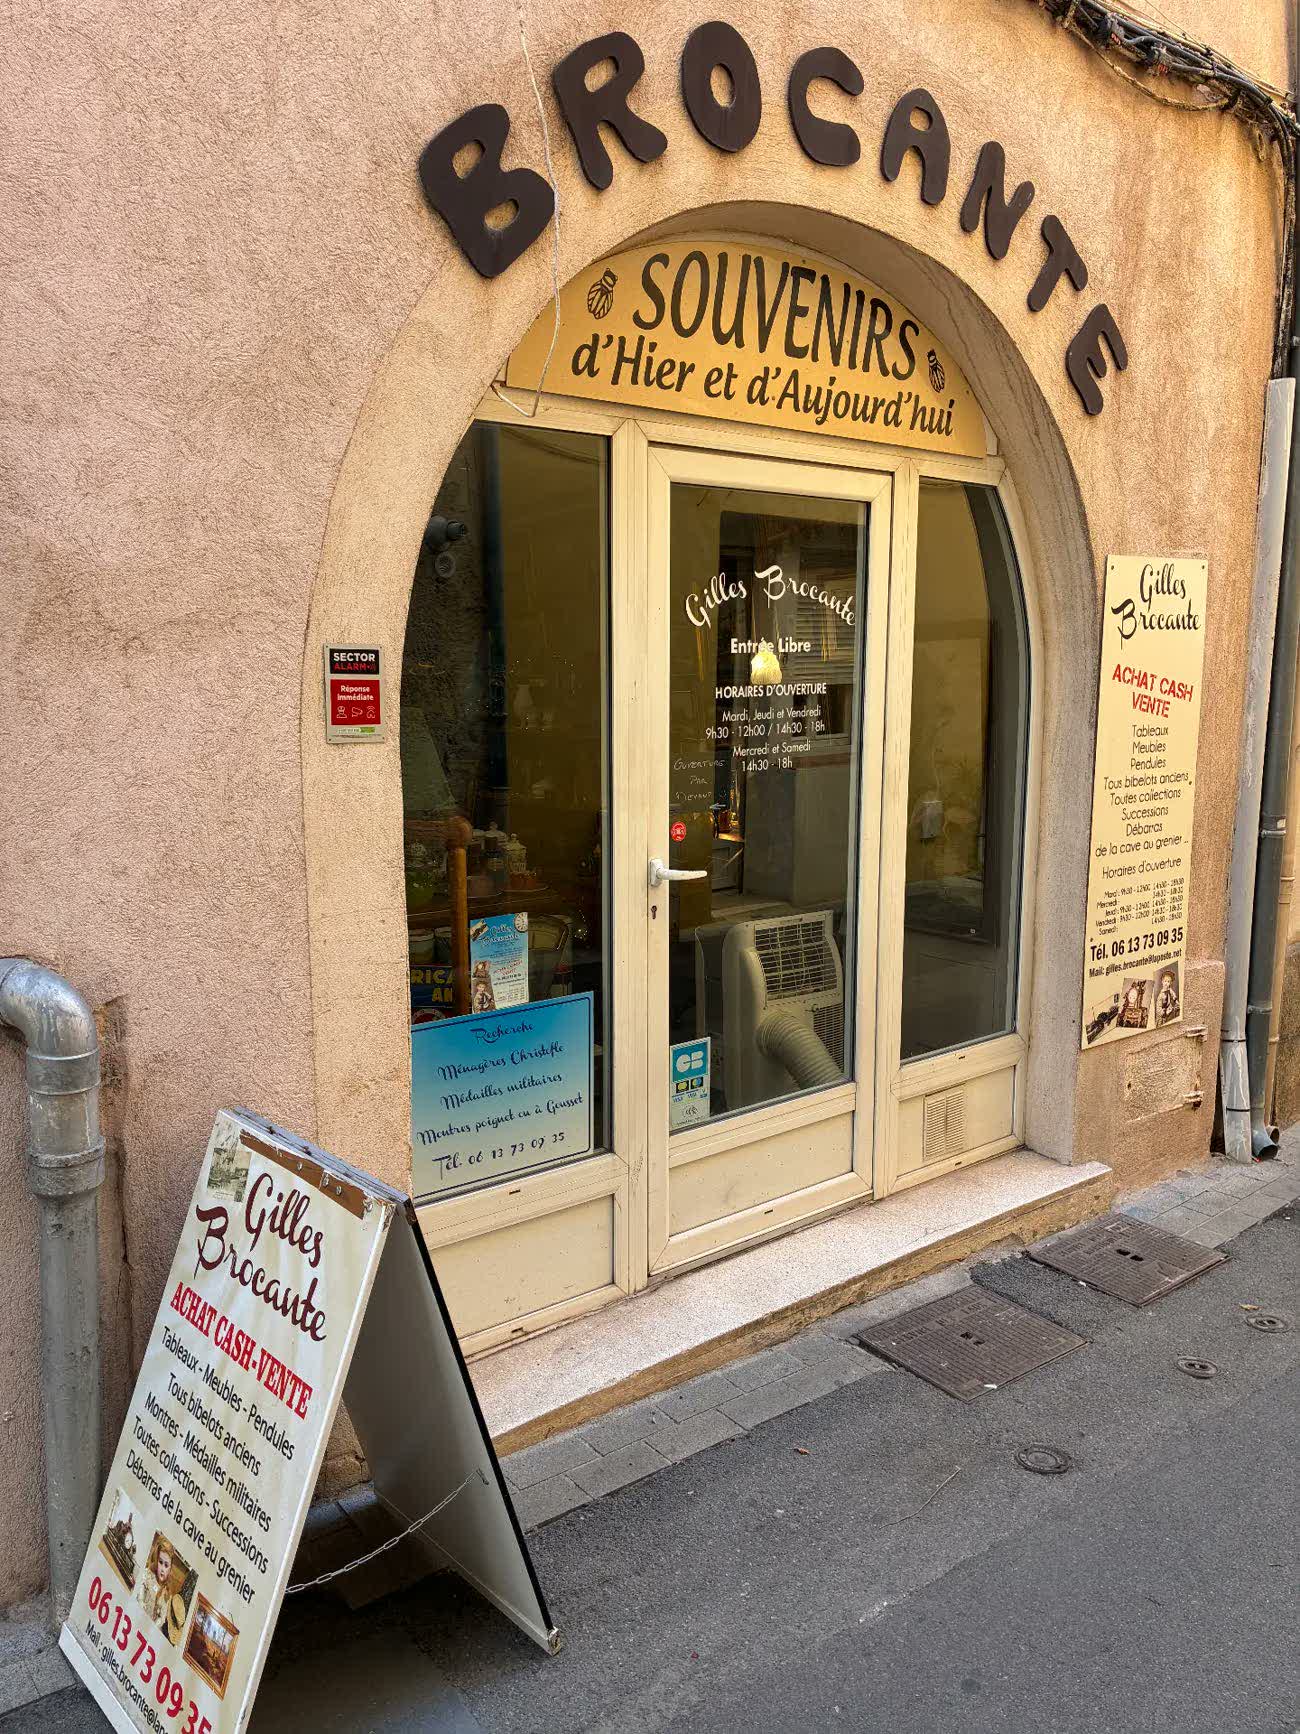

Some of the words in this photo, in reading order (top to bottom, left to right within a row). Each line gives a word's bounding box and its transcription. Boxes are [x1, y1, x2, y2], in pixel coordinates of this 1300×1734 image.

[419, 20, 1129, 416] BROCANTE
[632, 251, 920, 382] SOUVENIRS
[703, 361, 737, 399] et
[685, 572, 747, 629] Gilles
[754, 565, 856, 626] Brocante
[1139, 563, 1186, 611] Gilles
[1111, 598, 1201, 650] Brocante
[333, 652, 375, 662] SECTOR
[731, 637, 774, 653] Entrée
[778, 637, 811, 653] Libre
[334, 663, 367, 671] ALARM
[1112, 663, 1157, 692] ACHAT
[1159, 677, 1194, 702] CASH
[337, 693, 374, 701] Immédiate
[340, 685, 370, 693] Réponse
[715, 685, 763, 699] HORAIRES
[722, 708, 750, 723] Mardi,
[753, 707, 774, 721] Jeudi
[777, 708, 784, 719] et
[787, 705, 821, 719] Vendredi
[1131, 691, 1171, 719] VENTE
[705, 727, 729, 740] 9h30
[738, 724, 765, 737] 12h00
[767, 723, 773, 737] /
[776, 722, 802, 735] 14h30
[811, 721, 825, 732] 18h
[1132, 724, 1169, 738] Tableaux
[733, 744, 770, 757] Mercredi
[772, 744, 780, 754] et
[781, 739, 811, 753] Samedi
[1132, 740, 1166, 754] Meubles
[741, 759, 769, 772] 14h30
[777, 756, 793, 769] 18h
[1130, 756, 1166, 770] Pendules
[1104, 776, 1122, 790] Tous
[1124, 773, 1157, 788] bibelots
[1159, 771, 1189, 784] anciens
[1110, 792, 1137, 806] Toutes
[1139, 788, 1181, 803] collections
[1121, 806, 1169, 821] Successions
[1126, 822, 1163, 837] Débarras
[1095, 844, 1107, 857] de
[1109, 842, 1118, 855] la
[1120, 841, 1141, 854] cave
[1143, 838, 1154, 850] au
[1155, 835, 1182, 849] grenier
[1102, 864, 1136, 879] Horaires
[1090, 943, 1109, 961] Tél.
[1111, 940, 1125, 957] 06
[1127, 936, 1140, 953] 13
[1142, 933, 1154, 949] 73
[1156, 930, 1169, 947] 09
[1170, 927, 1183, 943] 35
[470, 1020, 534, 1043] Recherche
[437, 1058, 506, 1081] Ménagères
[510, 1041, 565, 1065] Christofle
[440, 1084, 503, 1110] Médailles
[507, 1074, 562, 1093] militaires
[416, 1125, 471, 1146] Montres
[475, 1109, 515, 1133] poignet
[518, 1110, 531, 1119] ou
[535, 1105, 543, 1114] à
[546, 1092, 584, 1115] Gousset
[432, 1152, 462, 1180] Tél.
[468, 1151, 483, 1165] 06
[492, 1148, 504, 1160] 13
[510, 1143, 524, 1156] 73
[531, 1136, 545, 1149] 09
[552, 1132, 565, 1143] 35
[244, 1172, 324, 1268] Gilles
[194, 1204, 328, 1342] Brocante
[169, 1281, 218, 1338] ACHAT
[161, 1325, 199, 1372] Tableaux
[201, 1363, 242, 1413] Meubles
[248, 1404, 295, 1461] Pendules
[167, 1371, 188, 1404] Tous
[187, 1392, 224, 1441] bibelots
[222, 1431, 262, 1477] anciens
[145, 1391, 180, 1437] Montres
[183, 1430, 225, 1487] Médailles
[226, 1477, 272, 1533] militaires
[132, 1415, 160, 1453] Toutes
[159, 1447, 205, 1506] collections
[209, 1498, 269, 1574] Successions
[126, 1449, 162, 1501] Débarras
[162, 1491, 174, 1515] de
[174, 1504, 184, 1527] la
[183, 1516, 205, 1549] cave
[204, 1541, 218, 1563] au
[217, 1555, 256, 1605] grenier
[88, 1576, 113, 1625] 06
[111, 1605, 132, 1651] 13
[130, 1630, 156, 1684] 73
[155, 1666, 183, 1718] 09
